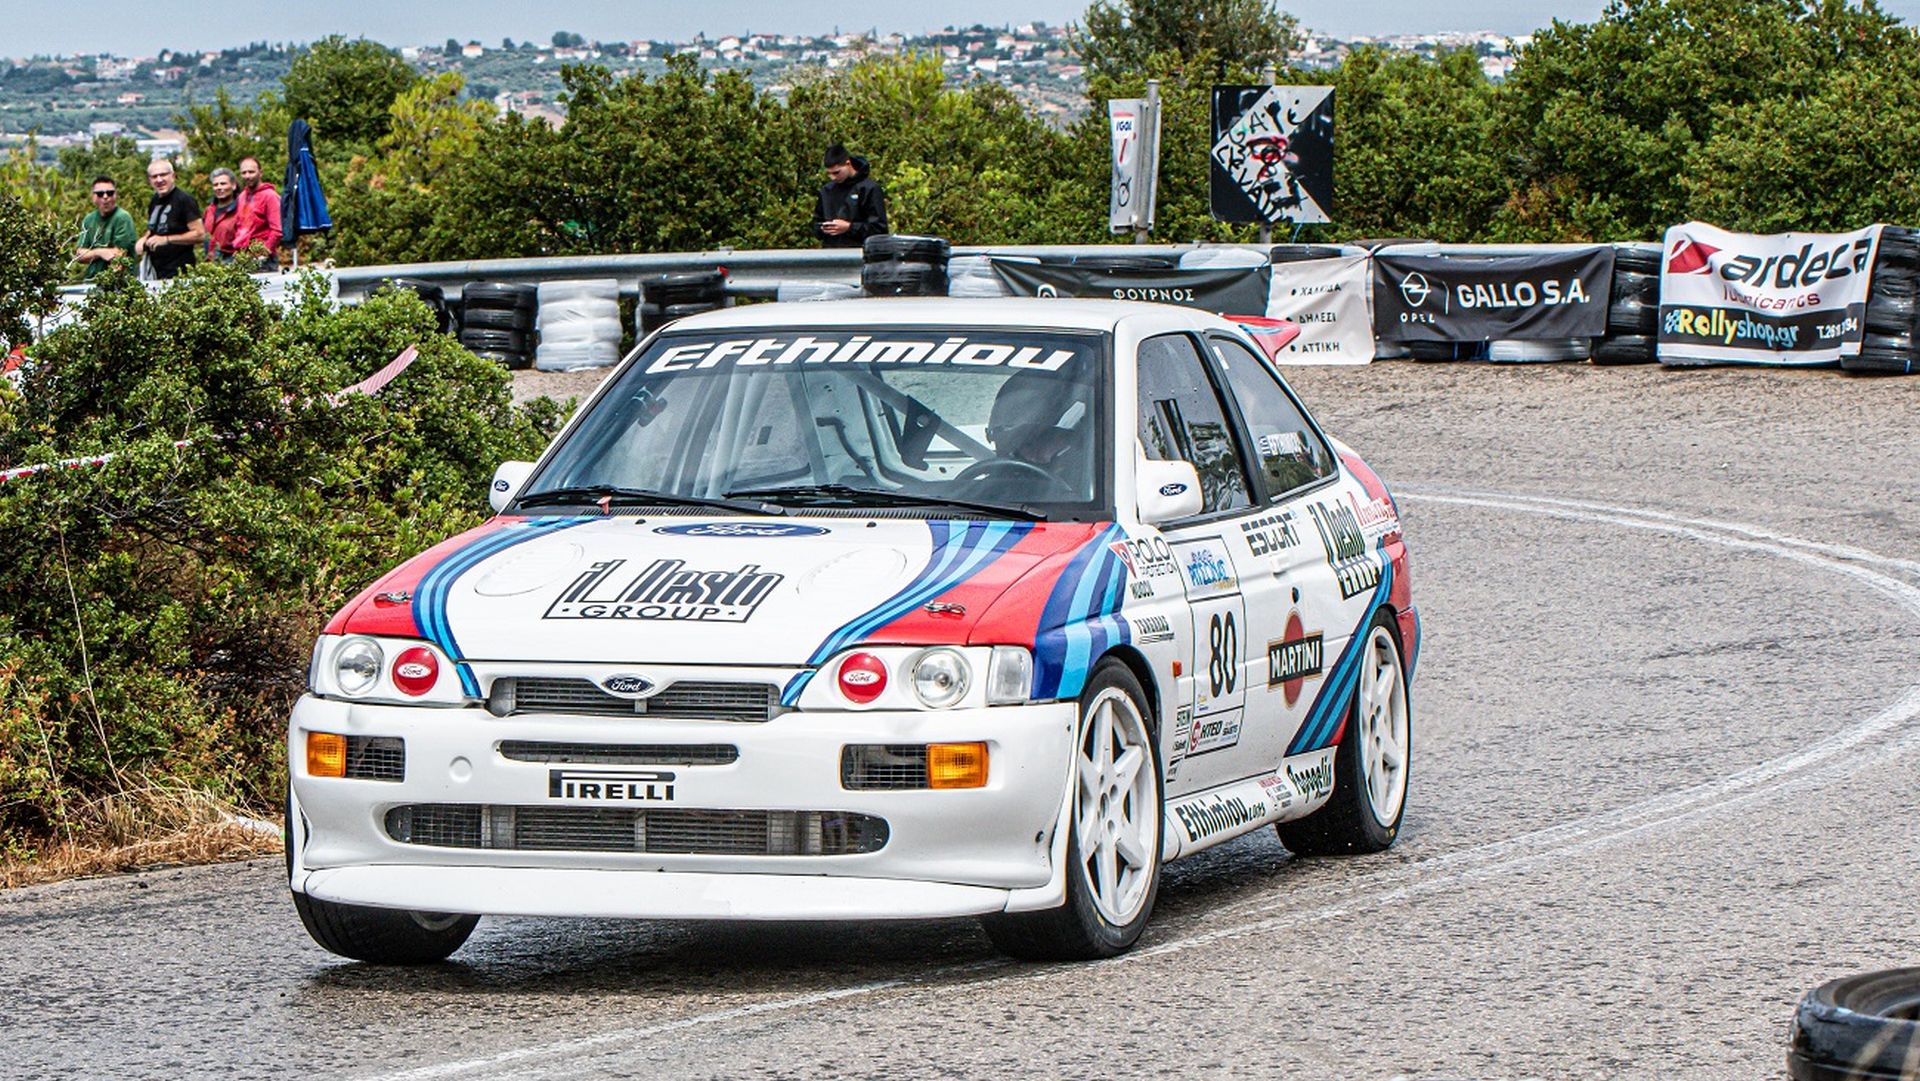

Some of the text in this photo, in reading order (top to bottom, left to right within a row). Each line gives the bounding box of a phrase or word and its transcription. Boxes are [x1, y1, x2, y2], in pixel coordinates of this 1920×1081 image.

[1720, 238, 1872, 288] ardeca
[1113, 289, 1194, 301] ΦΟΥΡΝΟΣ
[1457, 279, 1590, 309] GALLO S.A.
[1400, 313, 1435, 324] OPEL
[645, 336, 1075, 374] Efthimiou
[1302, 342, 1340, 353] ΑΤΤΙΚΗ
[687, 523, 798, 535] Ford
[1240, 512, 1301, 557] ESCORT
[1127, 536, 1171, 564] POLO
[1341, 561, 1380, 596] GROUP
[579, 605, 721, 620] GROUP
[1210, 611, 1237, 698] 80
[1271, 640, 1321, 679] MARTINI
[402, 664, 423, 676] Ford
[611, 678, 642, 691] Ford
[848, 672, 872, 683] Ford
[549, 769, 676, 801] PIRELLI
[1175, 794, 1249, 842] Efthimiou
